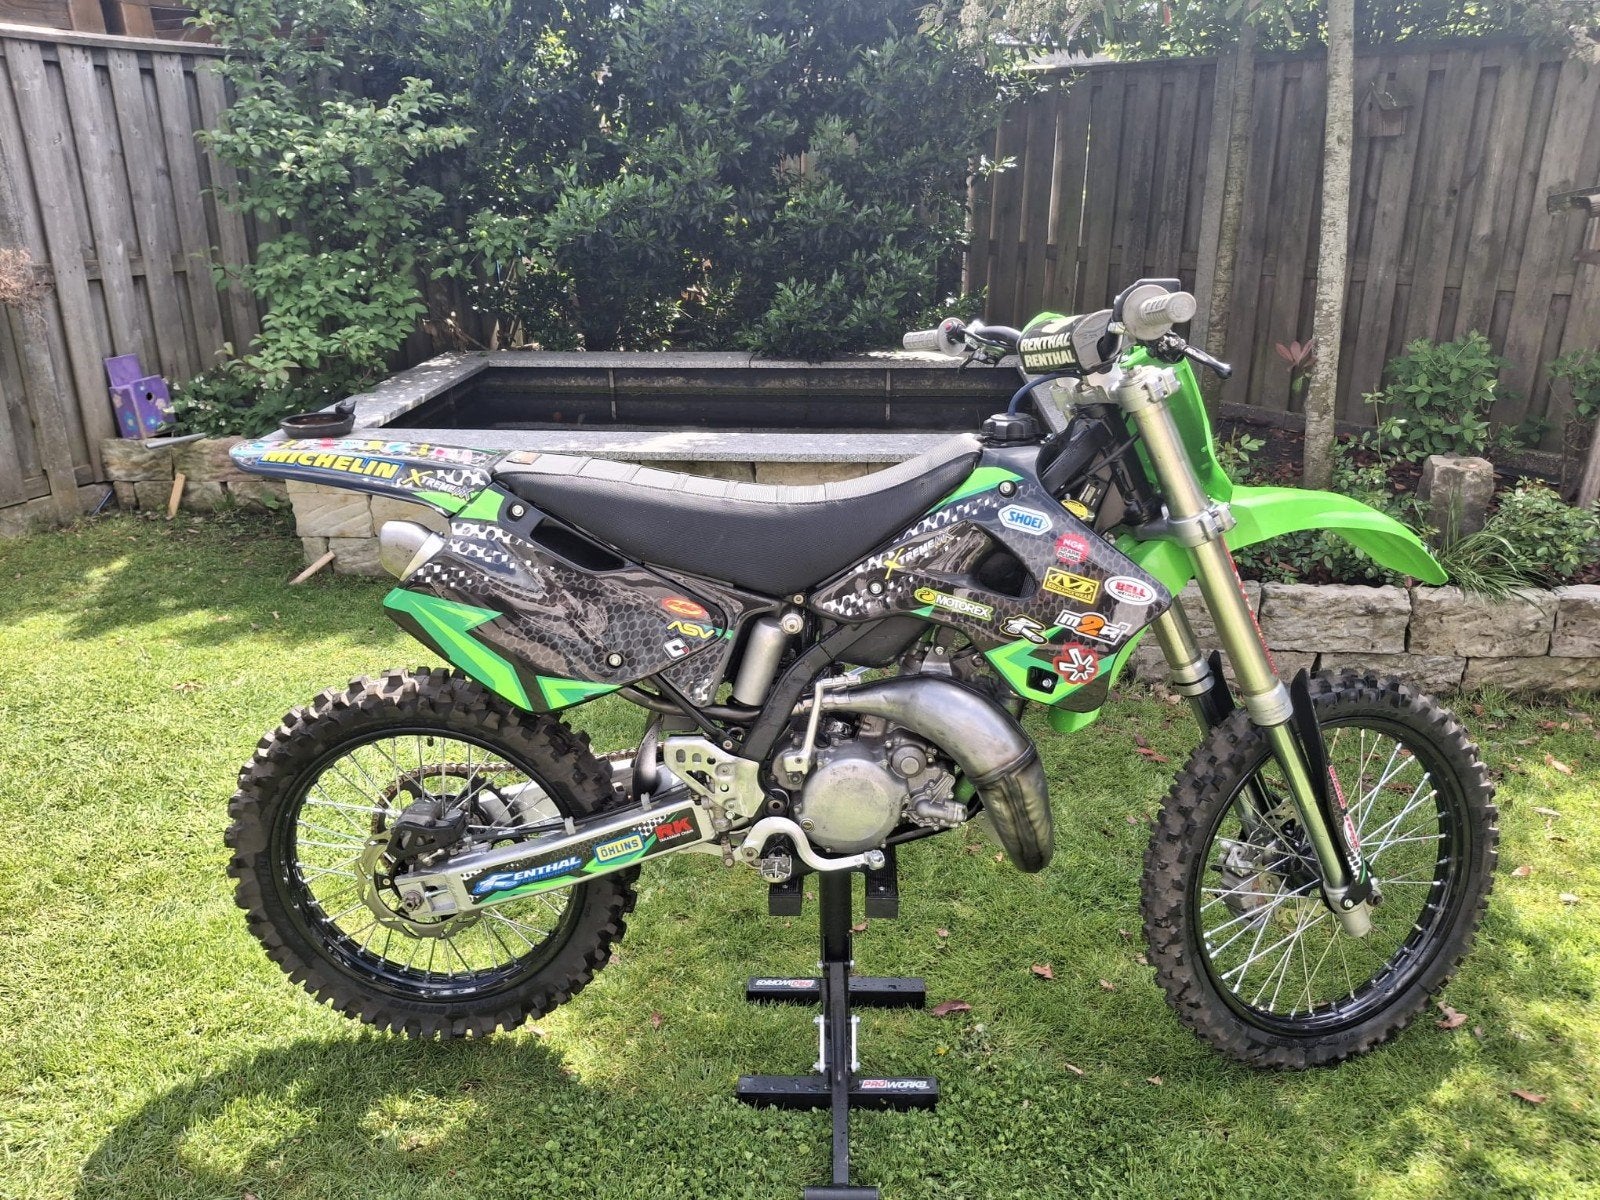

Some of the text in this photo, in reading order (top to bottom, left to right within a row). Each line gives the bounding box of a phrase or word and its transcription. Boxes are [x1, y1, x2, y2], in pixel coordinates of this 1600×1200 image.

[1020, 332, 1071, 352] RENTHAL
[1024, 350, 1076, 368] RENTHAL
[261, 450, 400, 479] MICHELIN
[1008, 510, 1043, 530] SHOEI
[1062, 538, 1085, 551] NGK
[1115, 581, 1146, 598] BELL
[934, 594, 992, 619] MOTOREX
[655, 817, 693, 839] RK
[600, 839, 639, 858] ÖHLINS
